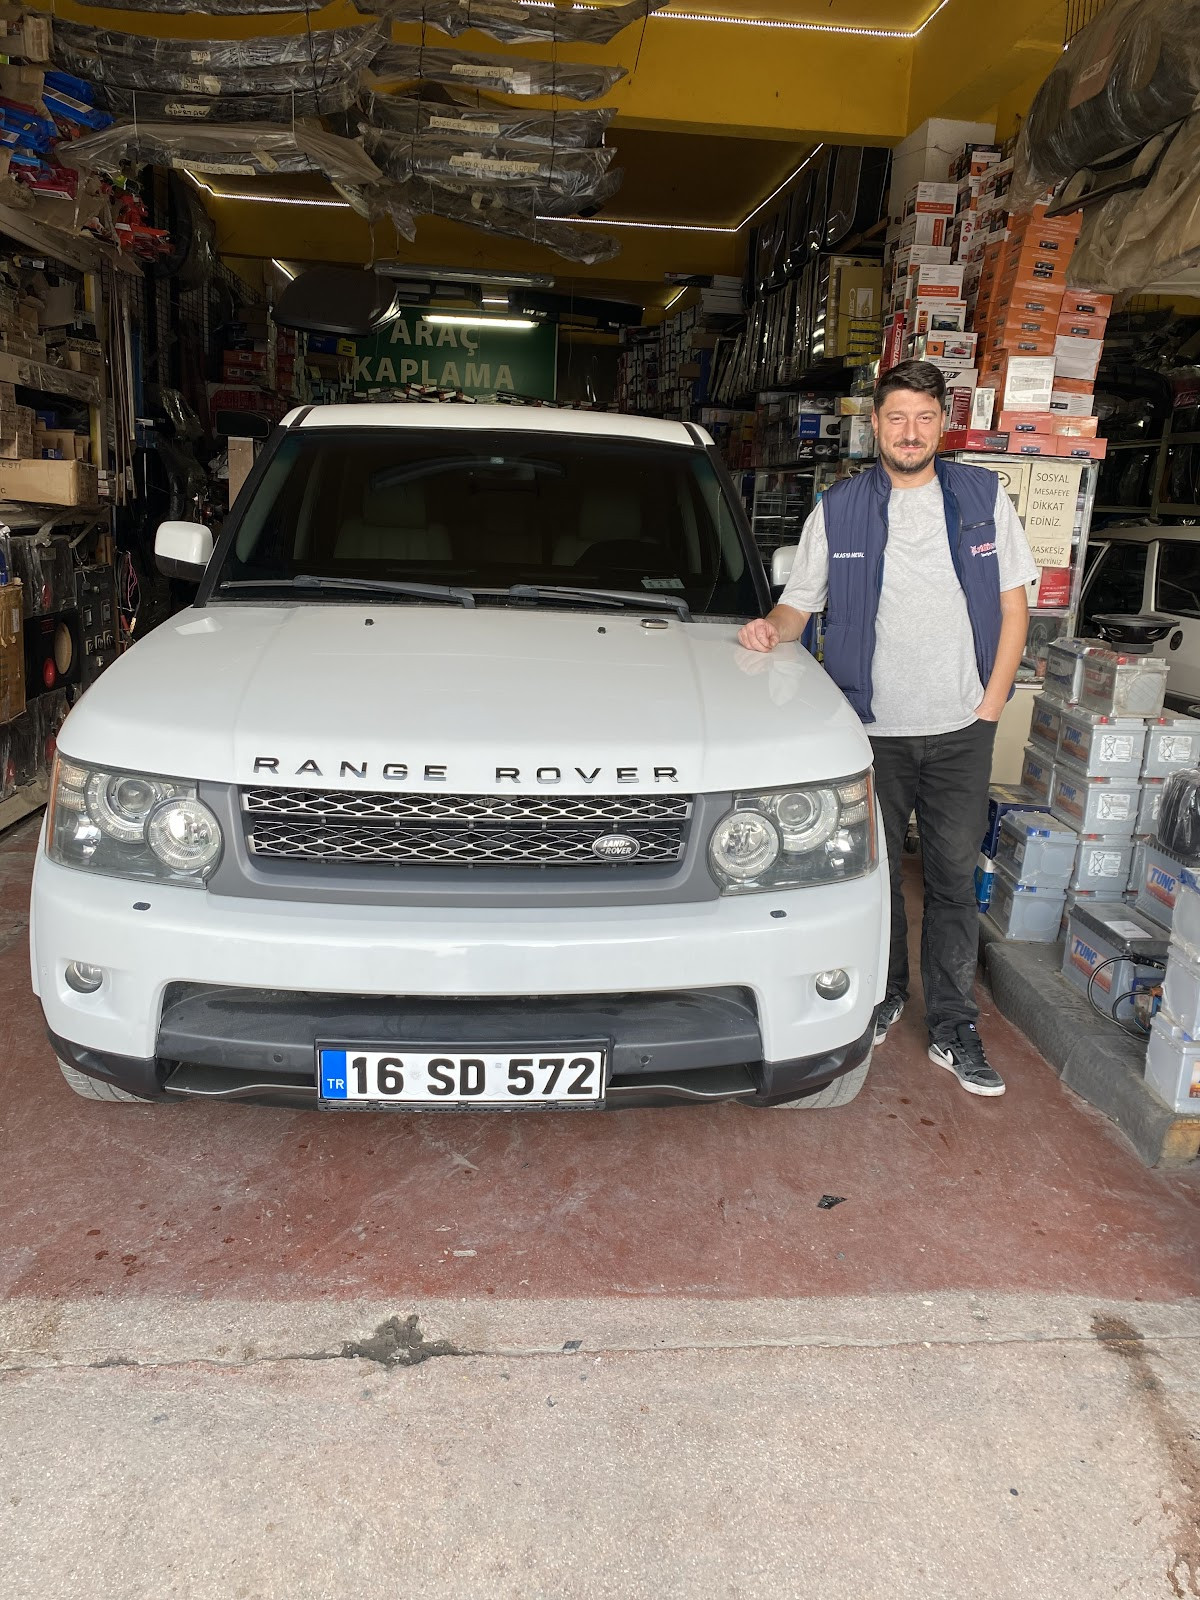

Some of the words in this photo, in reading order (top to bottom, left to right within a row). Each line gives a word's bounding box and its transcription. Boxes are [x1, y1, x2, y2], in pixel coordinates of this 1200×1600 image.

[389, 319, 479, 357] ARAÇ
[892, 322, 903, 369] ameson
[353, 355, 515, 390] KAPLAMA
[1036, 472, 1070, 484] SOSYAL
[1034, 487, 1070, 497] MESAFEYE
[1032, 500, 1065, 511] DİKKAT
[1030, 516, 1062, 527] EDİNİZ.
[252, 756, 448, 782] RANGE
[495, 766, 680, 784] ROVER
[603, 840, 626, 848] LAND
[605, 847, 632, 855] ROVER
[352, 1056, 404, 1095] 16
[426, 1057, 486, 1096] SD
[507, 1057, 595, 1096] 572
[327, 1078, 345, 1090] TR
